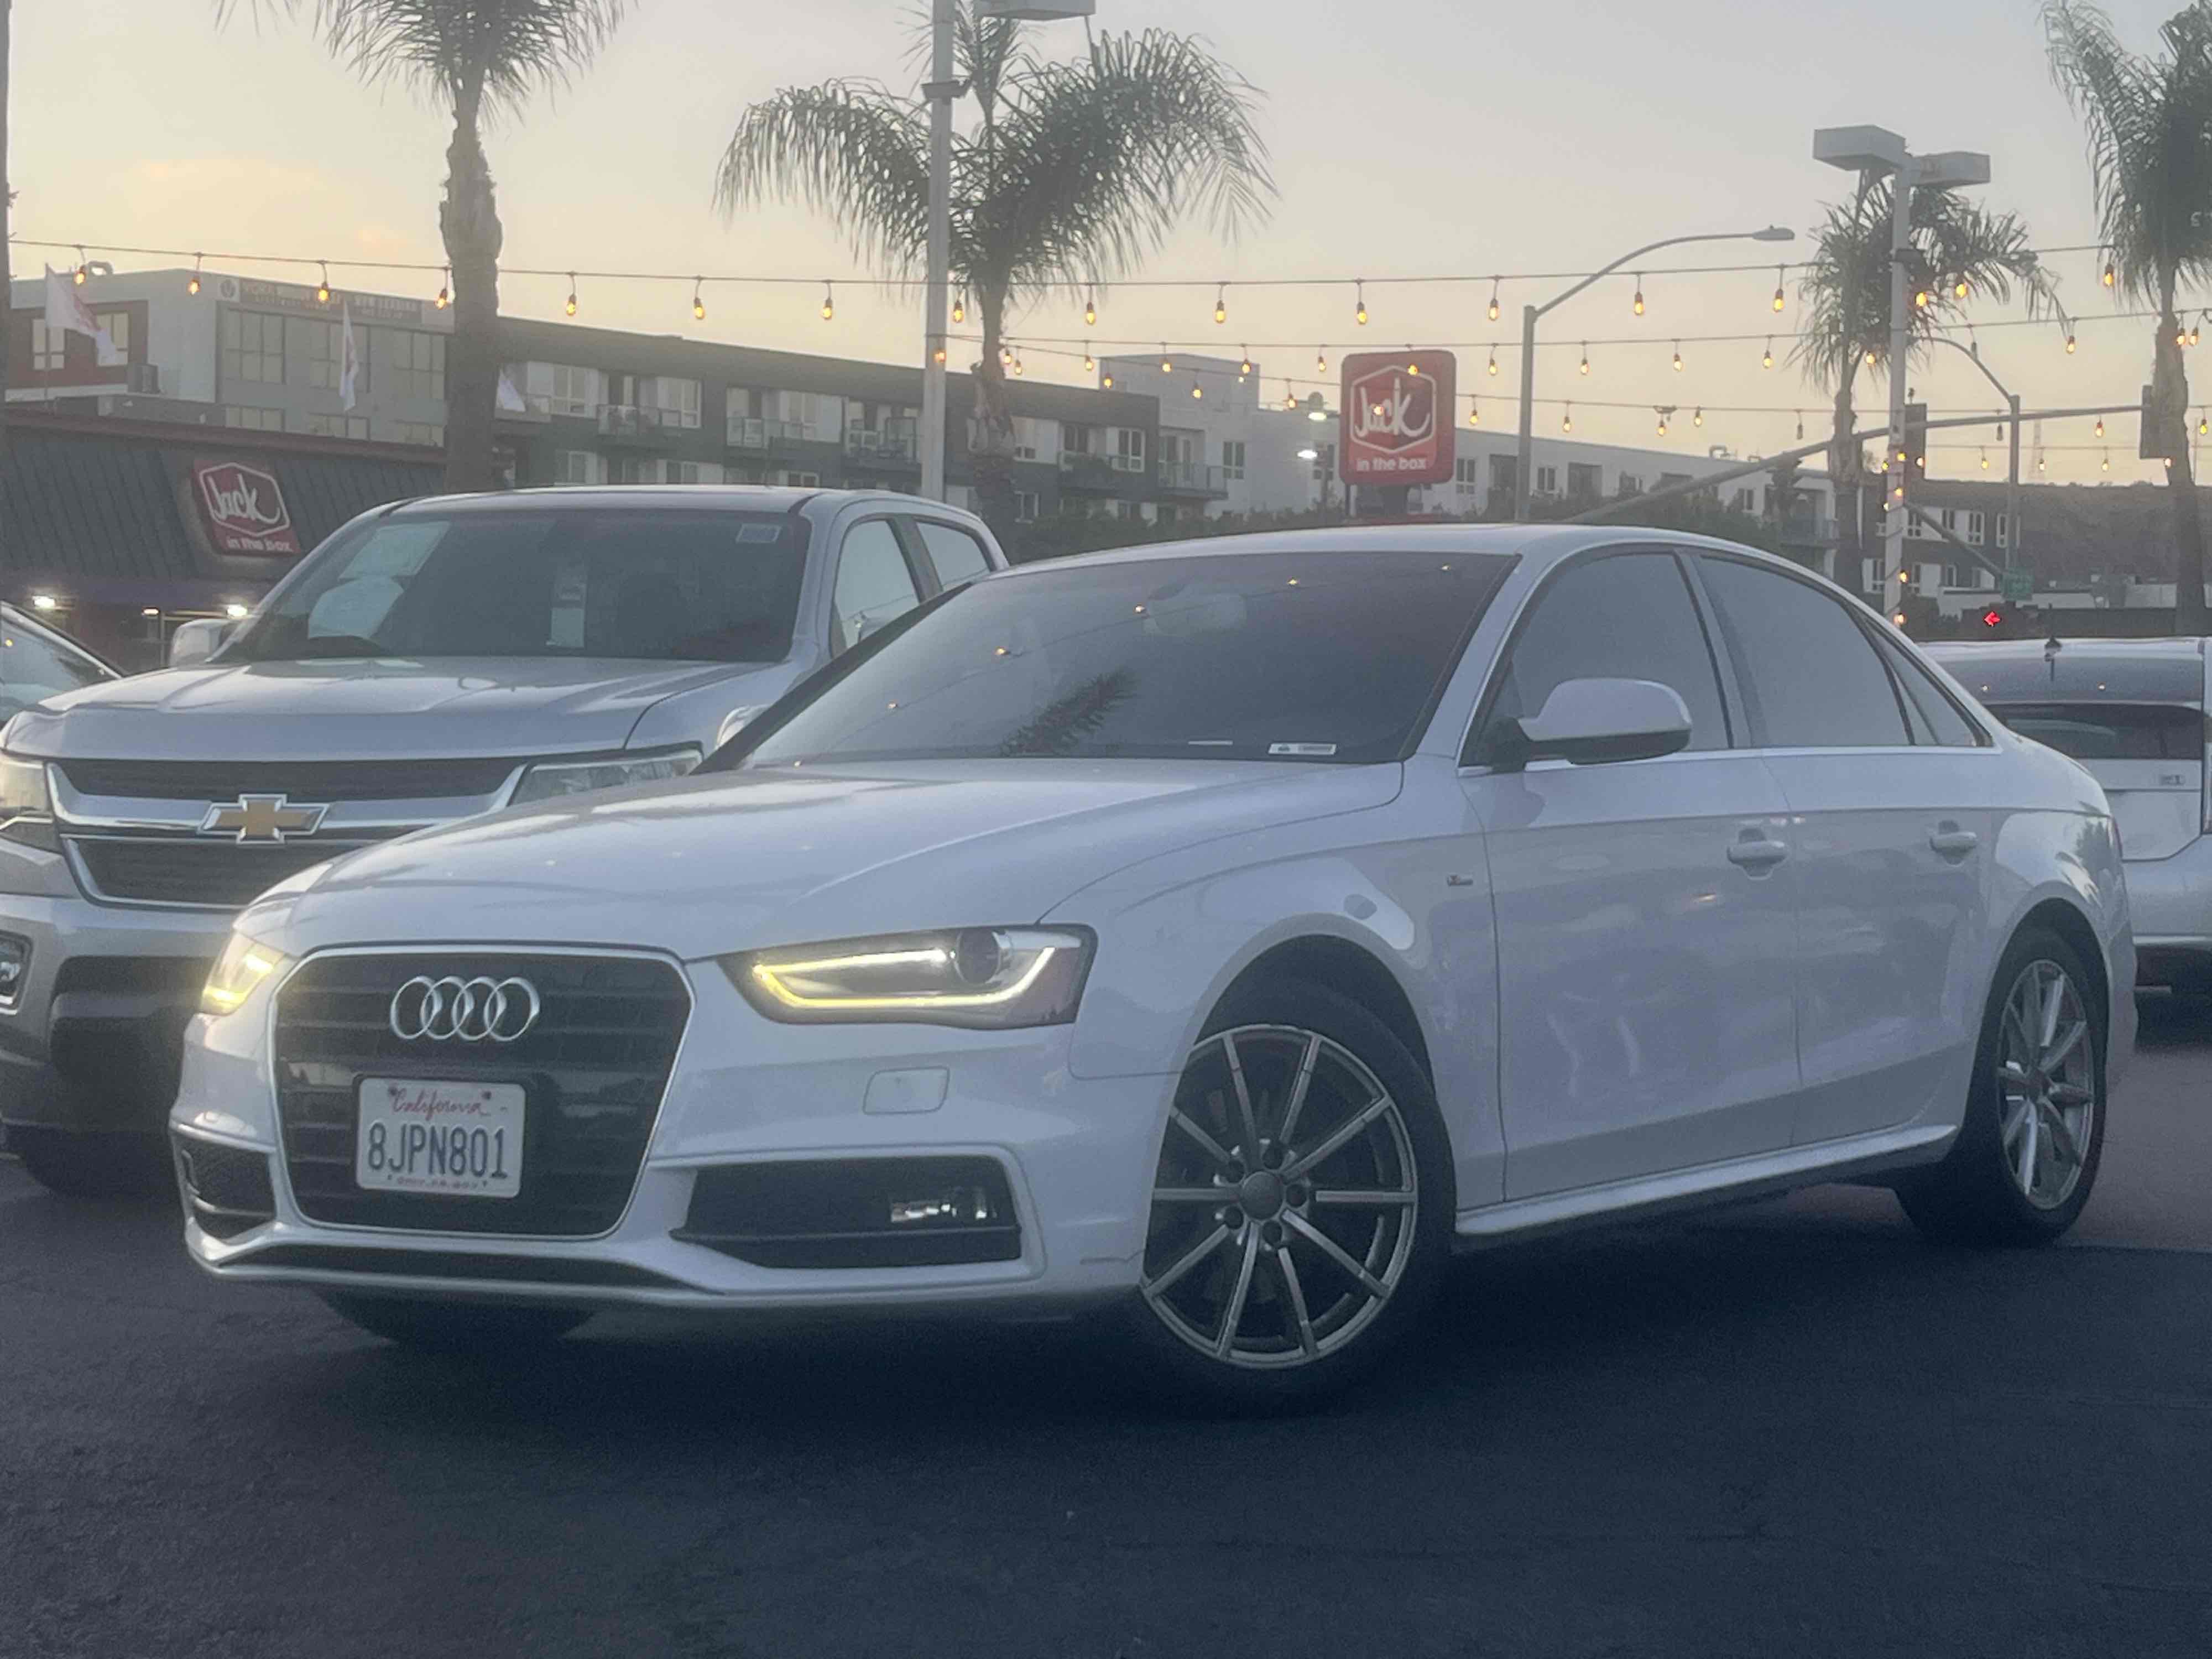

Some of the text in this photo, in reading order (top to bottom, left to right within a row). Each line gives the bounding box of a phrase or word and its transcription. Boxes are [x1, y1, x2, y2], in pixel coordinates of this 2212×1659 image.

[1355, 378, 1431, 437] Jack
[1356, 456, 1427, 471] in the box
[207, 473, 280, 524] Jack
[226, 536, 294, 552] in the box
[392, 1087, 492, 1121] California
[367, 1121, 508, 1178] 8JPN801
